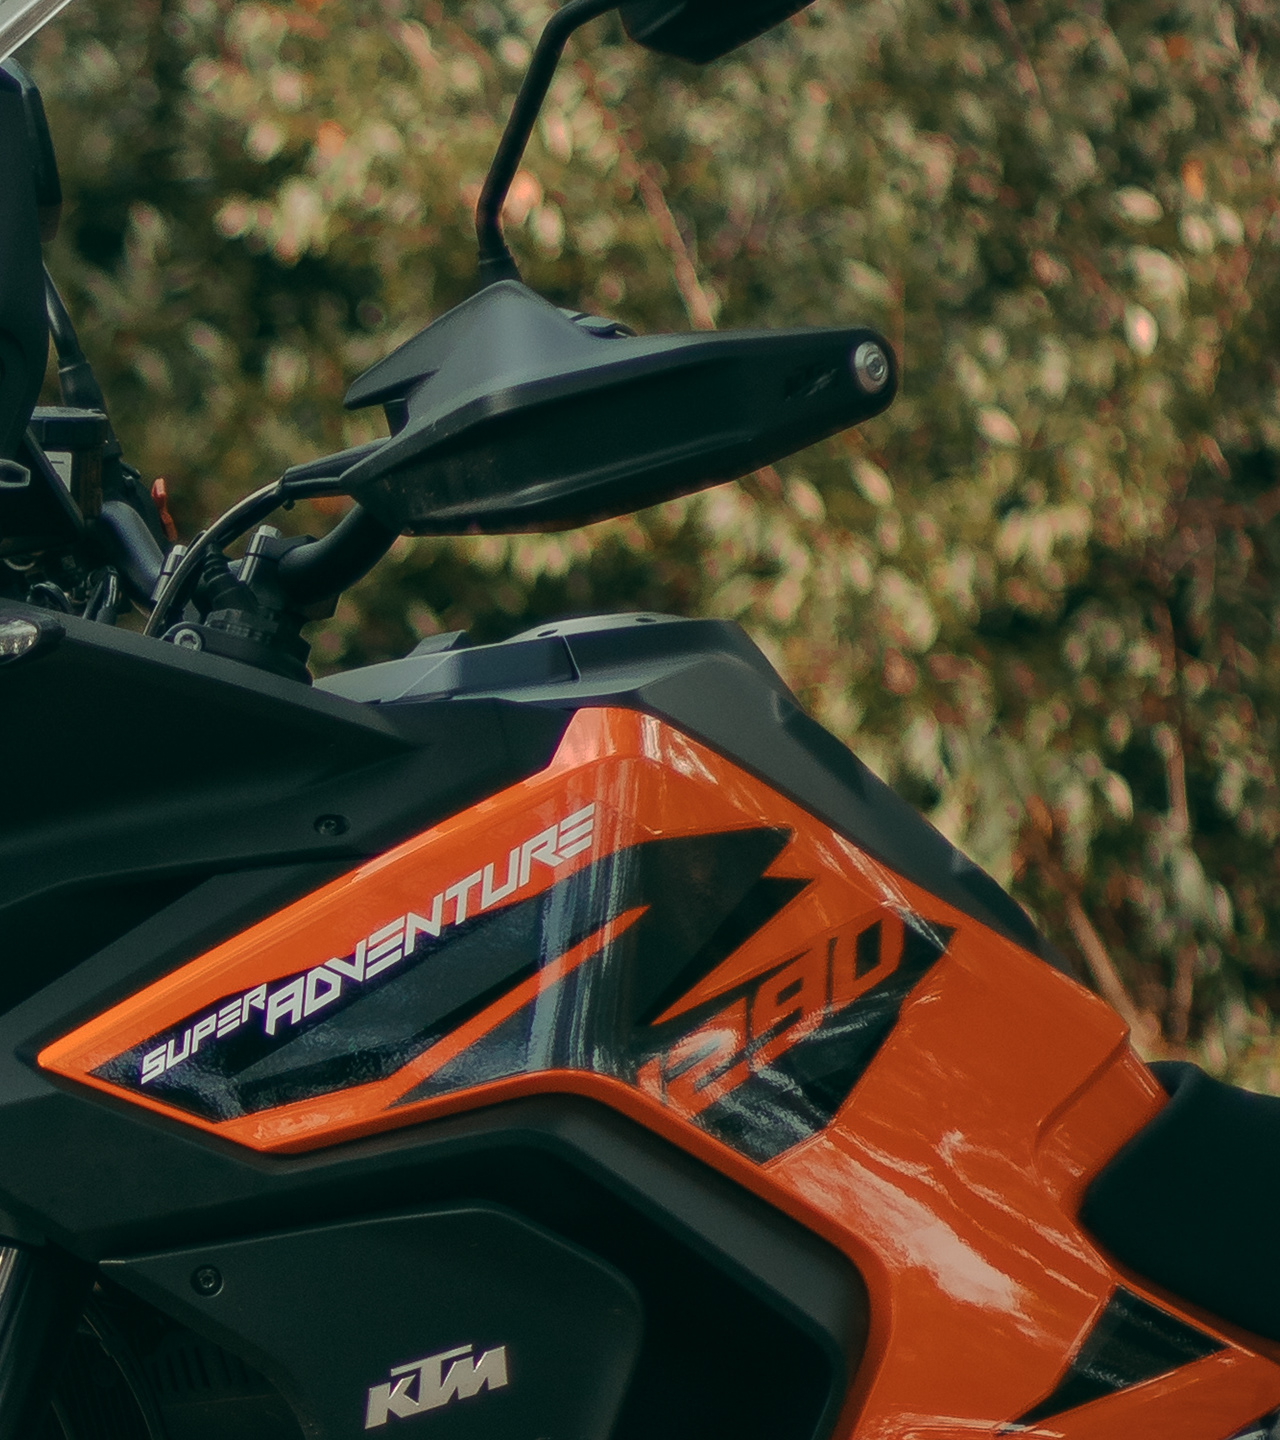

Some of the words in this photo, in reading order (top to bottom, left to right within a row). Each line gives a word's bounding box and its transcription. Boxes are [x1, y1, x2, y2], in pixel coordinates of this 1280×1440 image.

[140, 983, 267, 1084] SUPER
[264, 802, 595, 1035] ADVENTURE
[636, 908, 904, 1122] 1290
[365, 1343, 508, 1429] KTM
